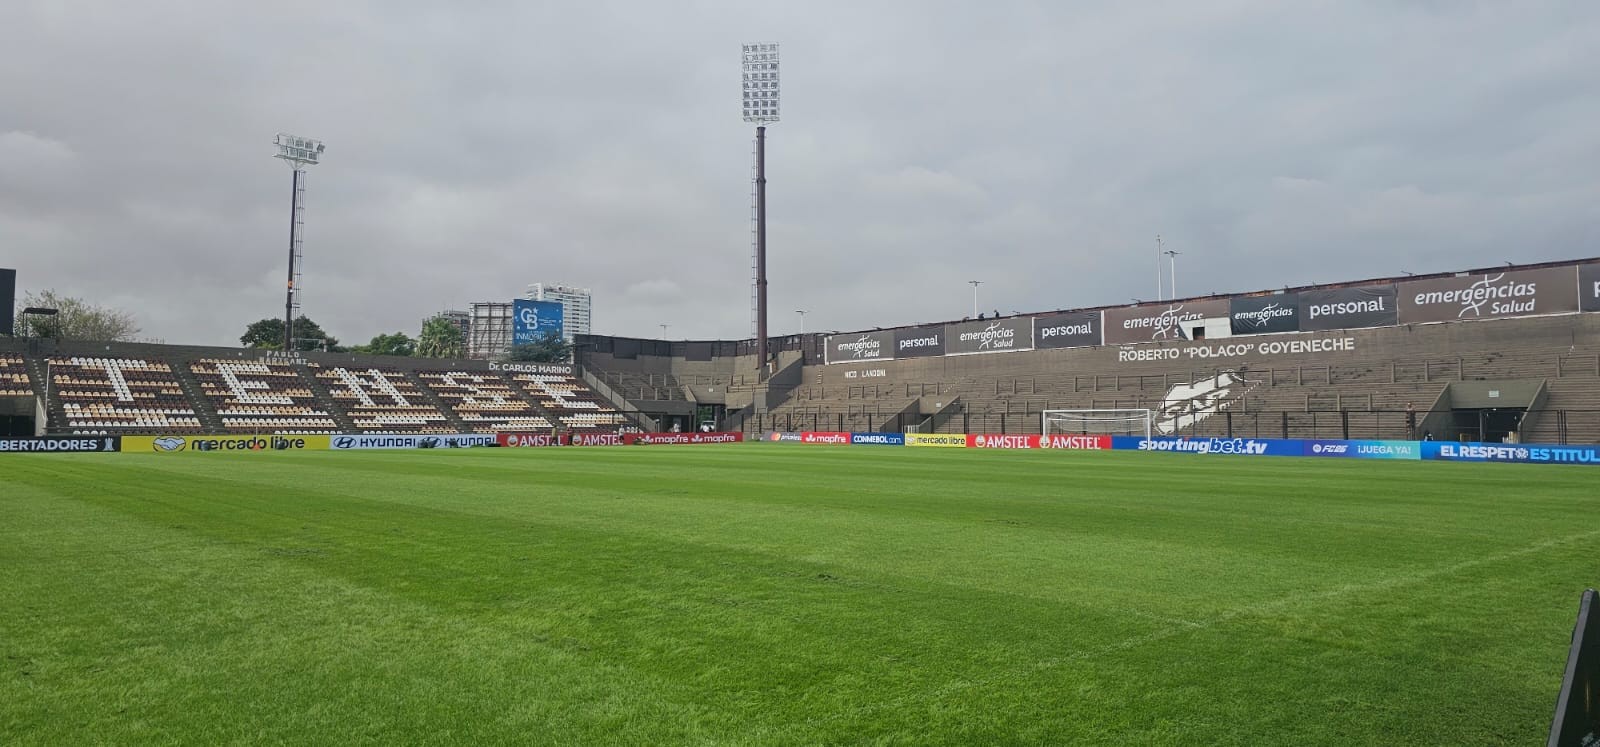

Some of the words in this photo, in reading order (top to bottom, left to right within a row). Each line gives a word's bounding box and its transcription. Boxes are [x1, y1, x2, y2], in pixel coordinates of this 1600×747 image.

[1414, 281, 1536, 305] emergencias
[1309, 297, 1385, 319] personal
[1491, 299, 1535, 314] Salud
[1235, 308, 1293, 320] emergencias
[960, 327, 1014, 343] emergencias
[1042, 322, 1092, 339] personal
[838, 340, 880, 352] emergencias
[900, 335, 938, 349] personal
[993, 339, 1014, 348] Salud
[266, 350, 300, 358] PABLO
[864, 350, 880, 358] Salud
[1118, 348, 1180, 362] ROBERTO
[1258, 338, 1355, 355] GOYENECHE
[488, 362, 500, 371] Dr.
[502, 363, 537, 373] CARLOS
[538, 365, 572, 374] MARINO
[359, 437, 416, 447] HYUNDAI
[655, 433, 688, 444] mapfre
[704, 433, 735, 443] mapfre
[816, 434, 846, 444] mapfre
[917, 434, 948, 444] mercado
[949, 434, 965, 445] libre
[986, 436, 1030, 448] AMSTEL
[1052, 437, 1100, 449] AMSTEL
[0, 439, 98, 451] BERTADORES
[1138, 437, 1267, 454] sportingbet.tv
[1440, 445, 1458, 457] EL
[1530, 448, 1550, 460] ES
